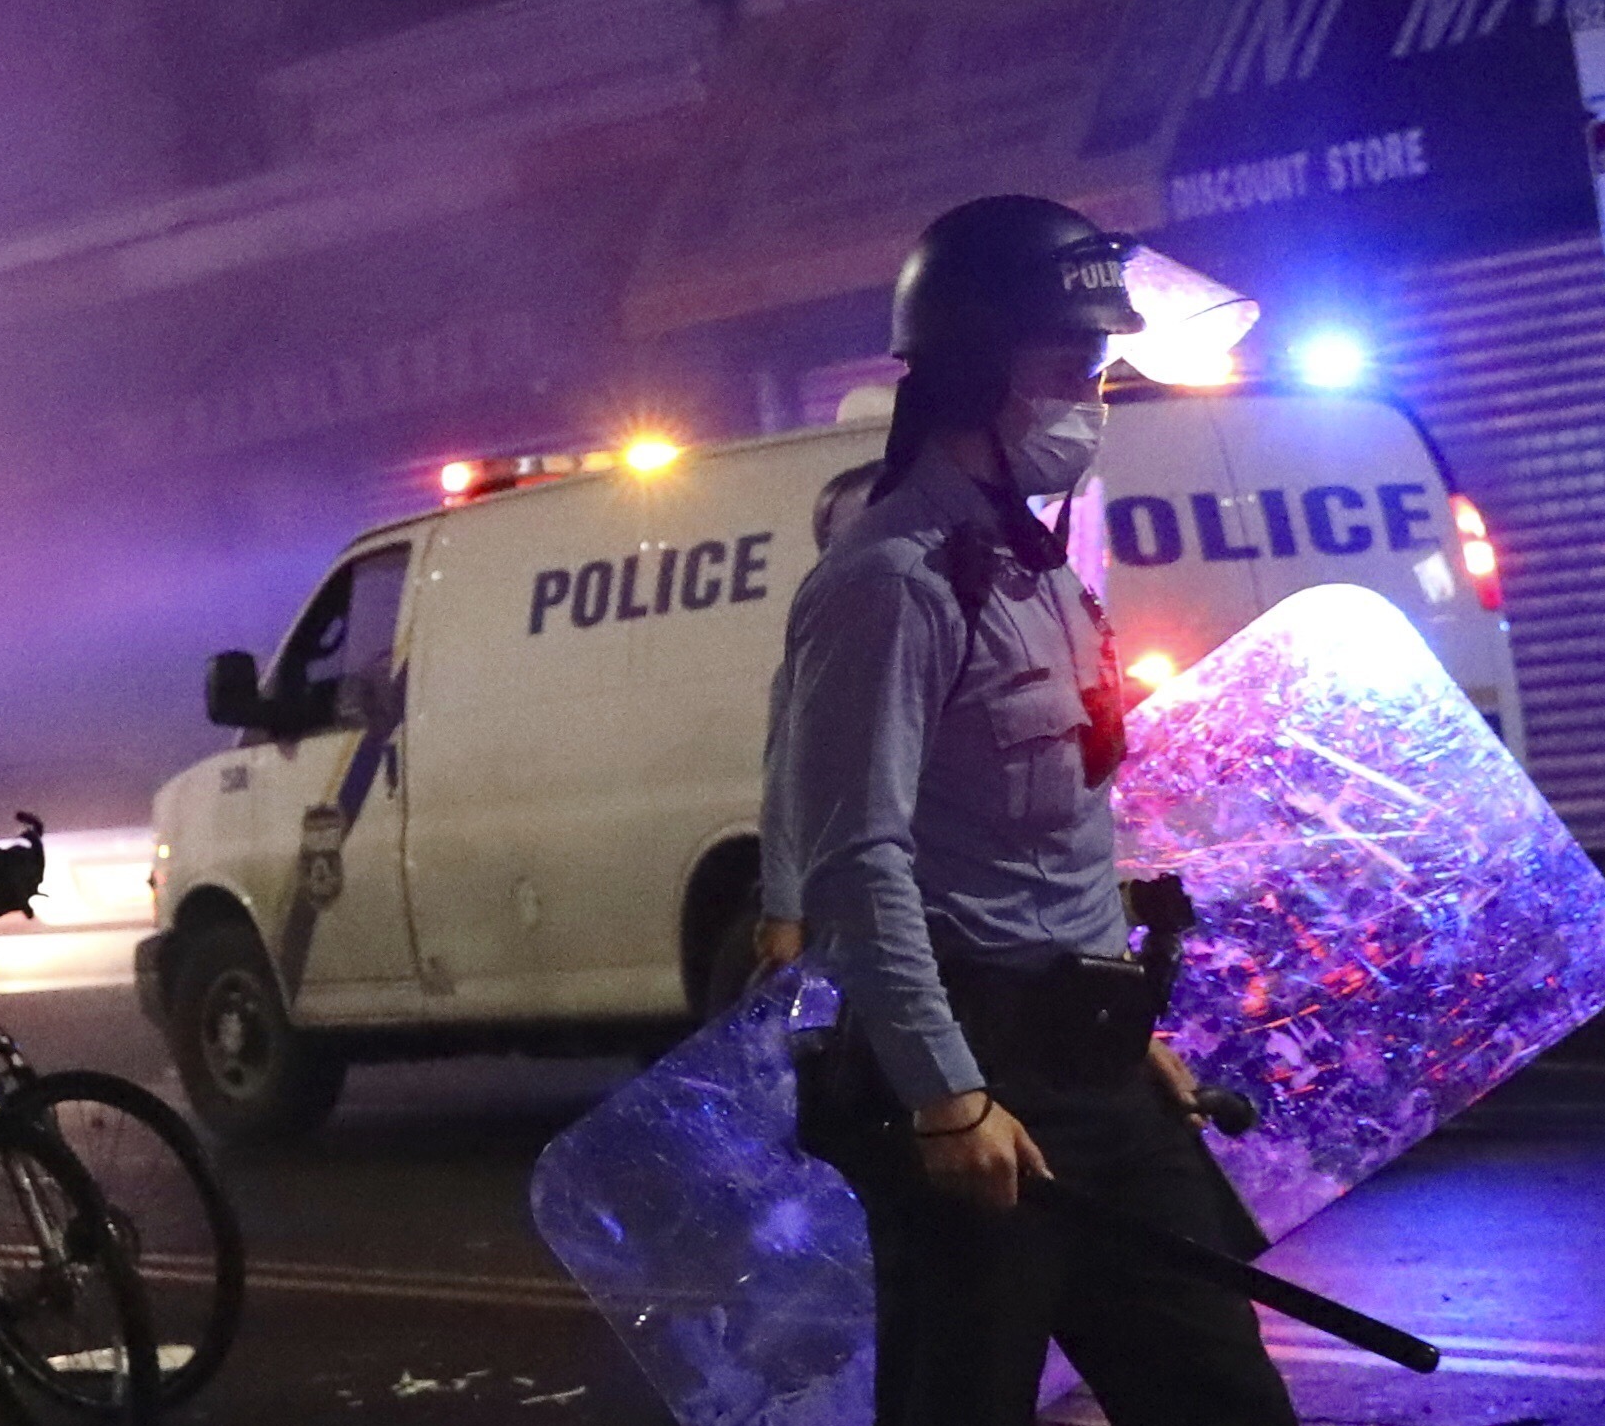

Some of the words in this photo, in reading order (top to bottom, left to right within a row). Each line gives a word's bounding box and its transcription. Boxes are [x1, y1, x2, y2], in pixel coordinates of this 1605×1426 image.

[1170, 149, 1310, 222] DISCOUNT
[1326, 126, 1430, 192] STORE
[1105, 483, 1442, 567] OLICE
[528, 532, 774, 636] POLICE
